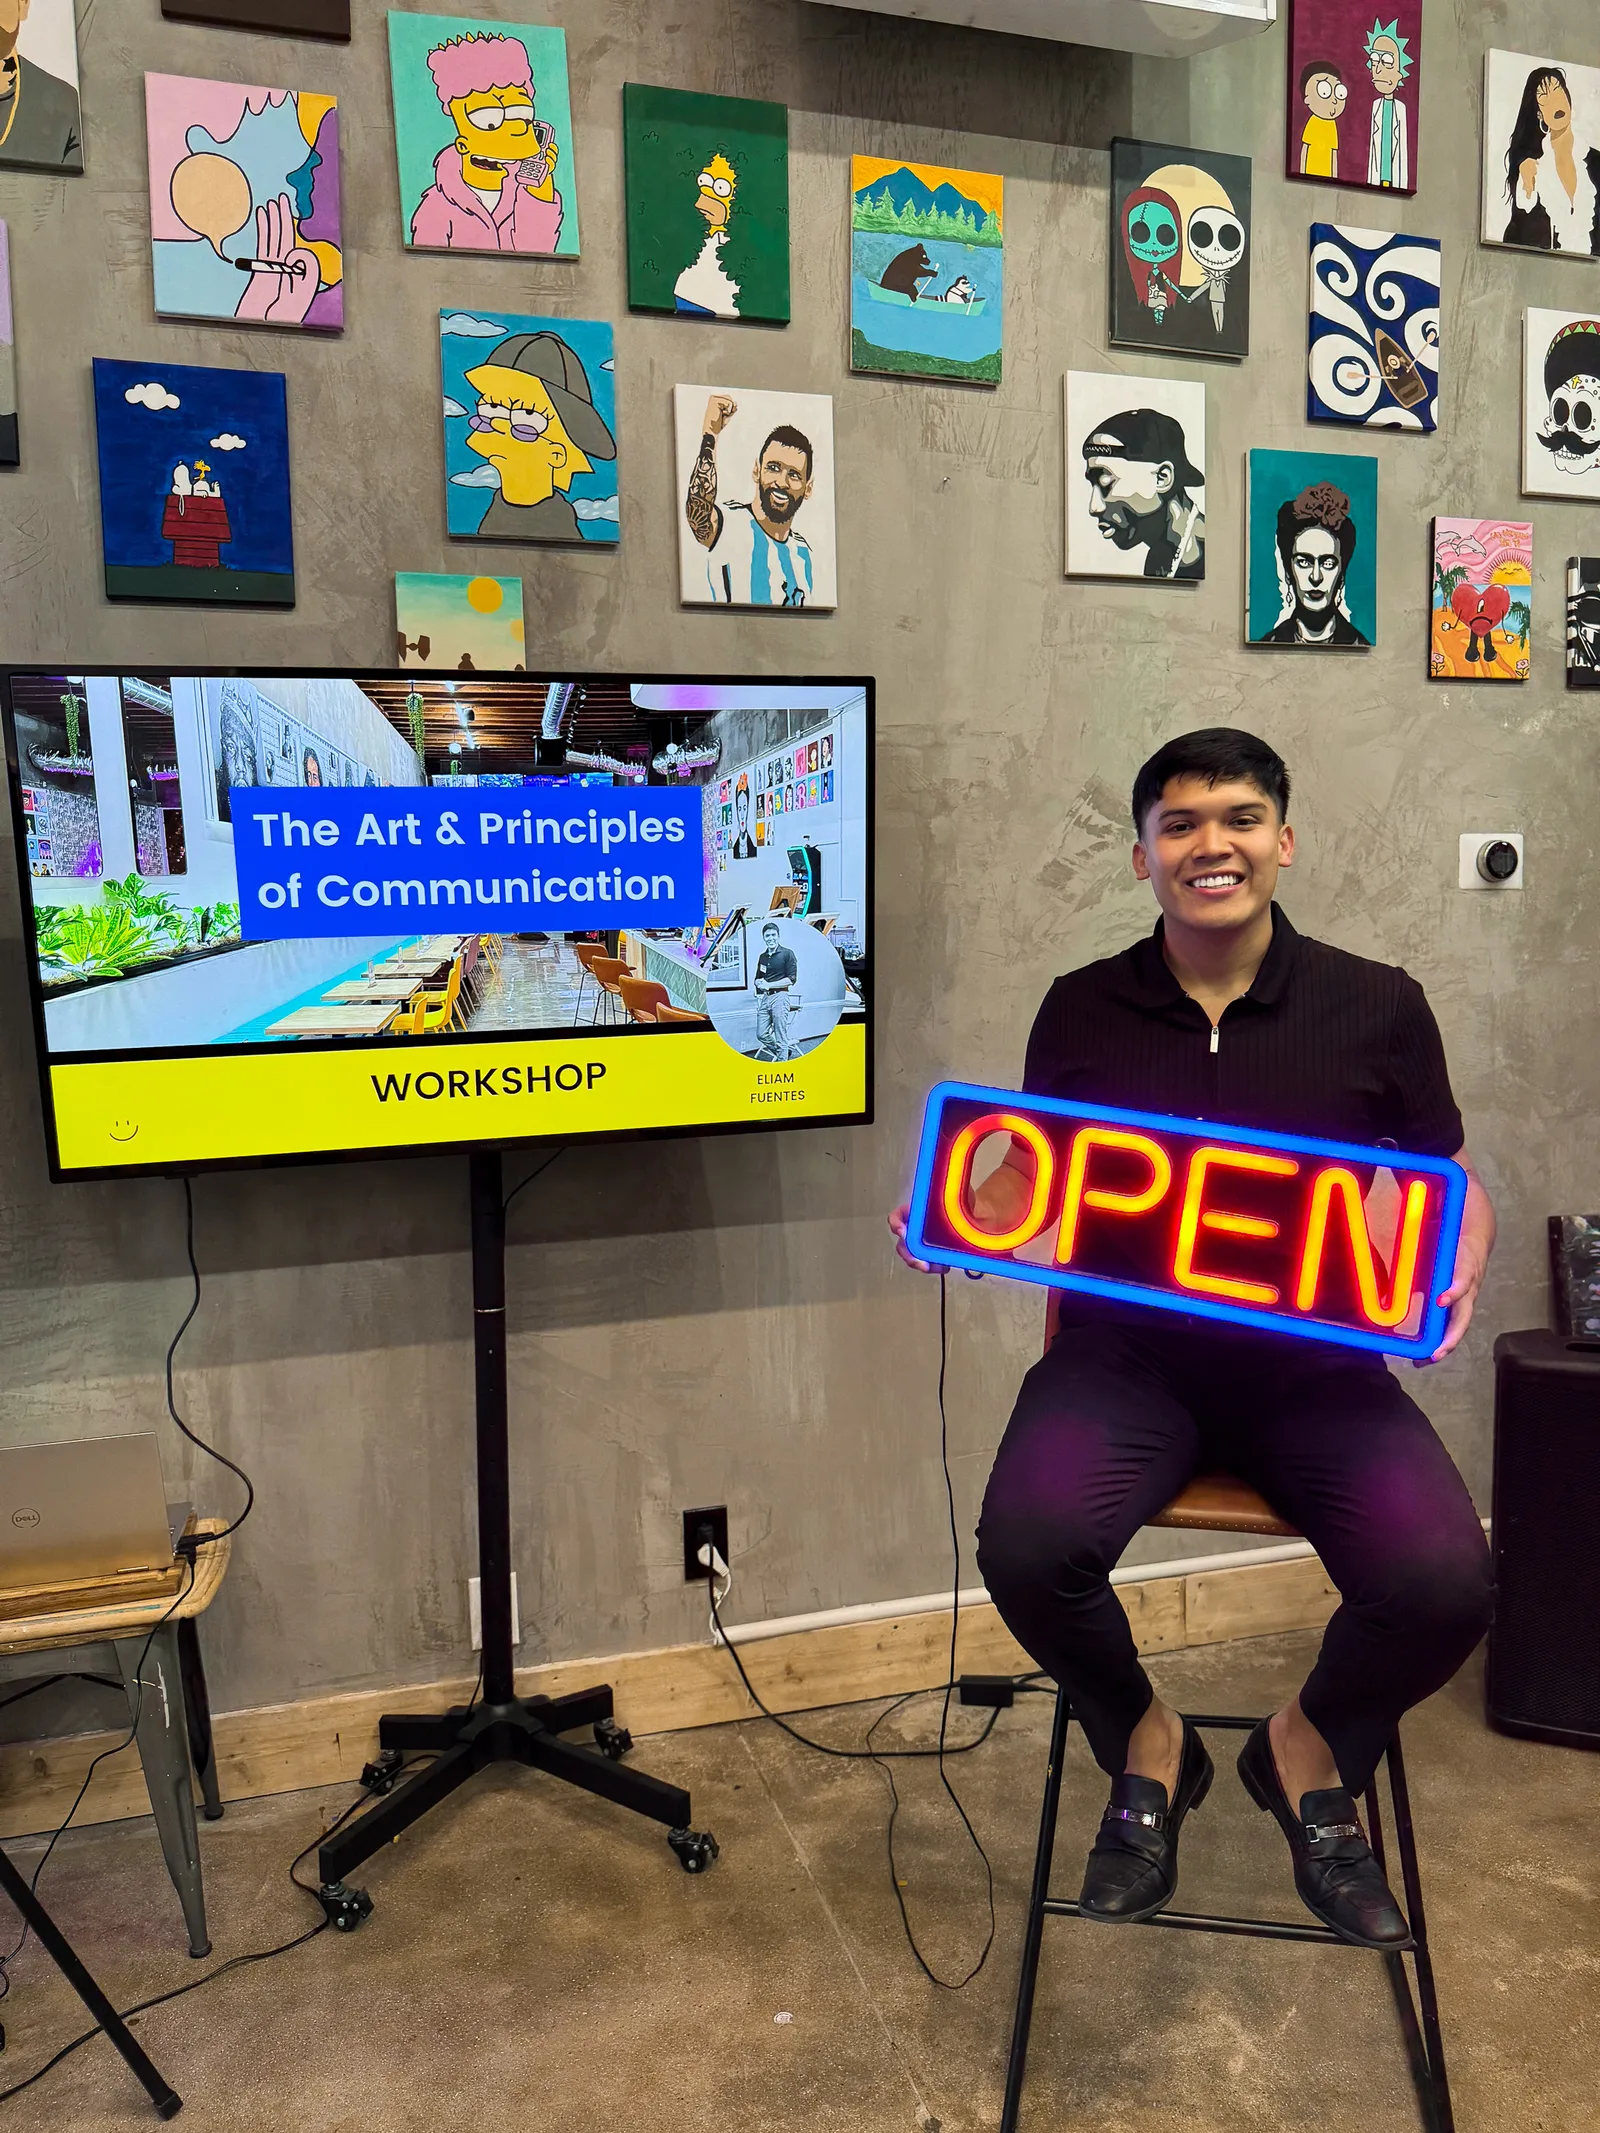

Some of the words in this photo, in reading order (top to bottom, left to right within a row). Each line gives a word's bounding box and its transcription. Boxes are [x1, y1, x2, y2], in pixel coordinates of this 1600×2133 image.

[253, 813, 340, 847] The
[356, 813, 422, 846] Art
[436, 811, 466, 845] &
[480, 809, 685, 854] Principles
[259, 873, 302, 909] of
[318, 867, 675, 907] Communication
[371, 1062, 606, 1103] WORKSHOP
[750, 1089, 805, 1103] FUENTES
[757, 1073, 794, 1085] ELIAM
[944, 1113, 1427, 1327] OPEN
